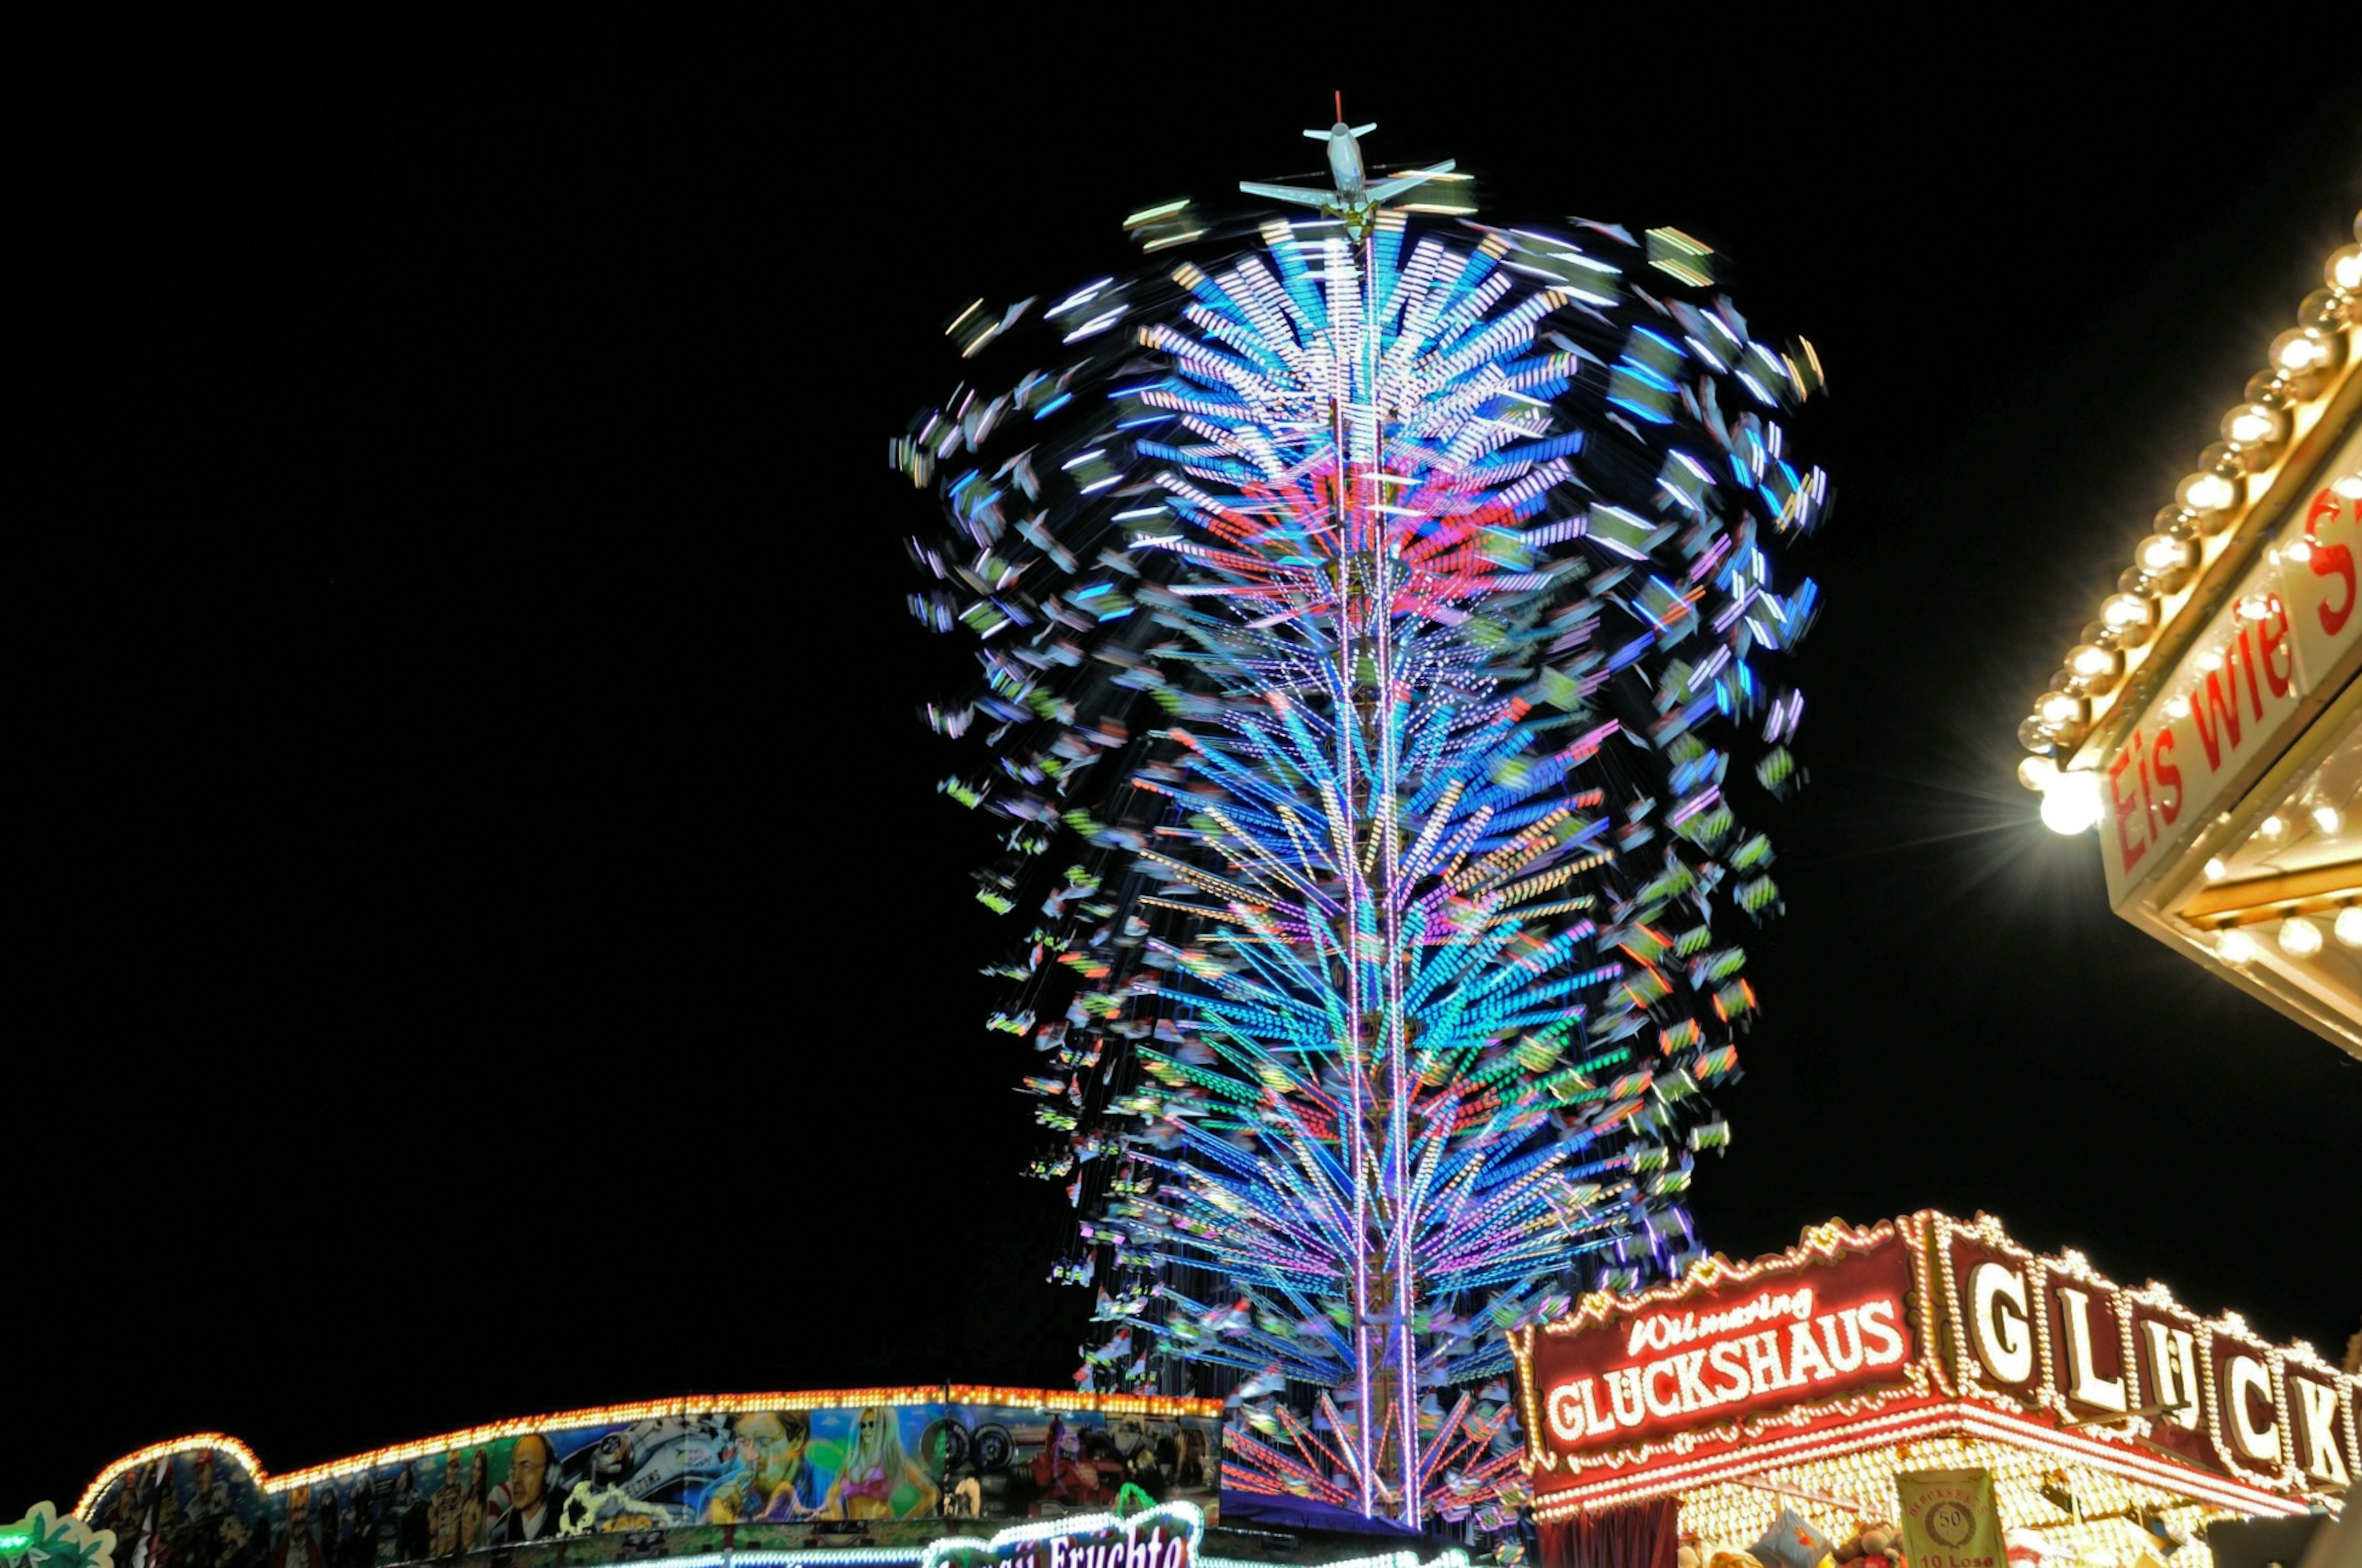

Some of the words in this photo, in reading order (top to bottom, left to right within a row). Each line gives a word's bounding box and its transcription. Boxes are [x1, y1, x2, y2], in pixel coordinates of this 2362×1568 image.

[2107, 728, 2184, 875] Eis
[2190, 591, 2293, 774] wie
[2305, 488, 2362, 637] S
[1547, 1299, 1904, 1442] GLÜCKSHAUS
[624, 1468, 661, 1496] ELTINS
[1939, 1510, 1962, 1527] 50
[1921, 1554, 1942, 1568] 10
[1948, 1554, 1994, 1568] Lose
